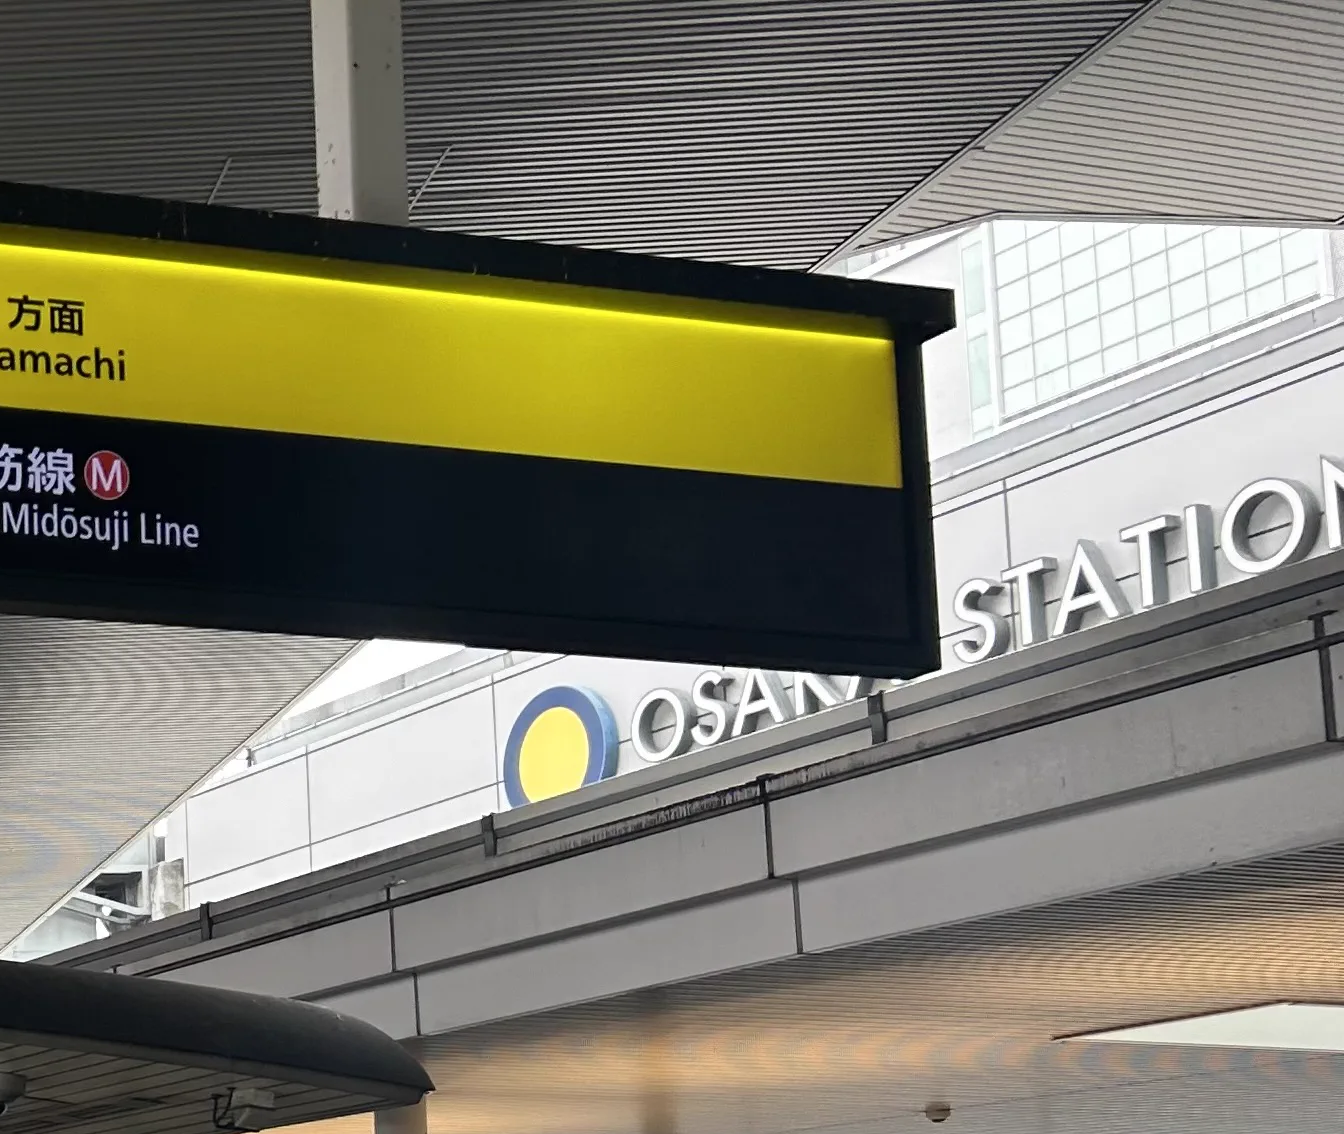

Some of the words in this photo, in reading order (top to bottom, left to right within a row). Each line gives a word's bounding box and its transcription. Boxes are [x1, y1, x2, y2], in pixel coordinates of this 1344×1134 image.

[7, 294, 86, 336] 方面
[88, 455, 127, 497] M
[1, 499, 130, 551] Midōsuji
[141, 510, 201, 548] Line
[631, 669, 909, 763] OSAK
